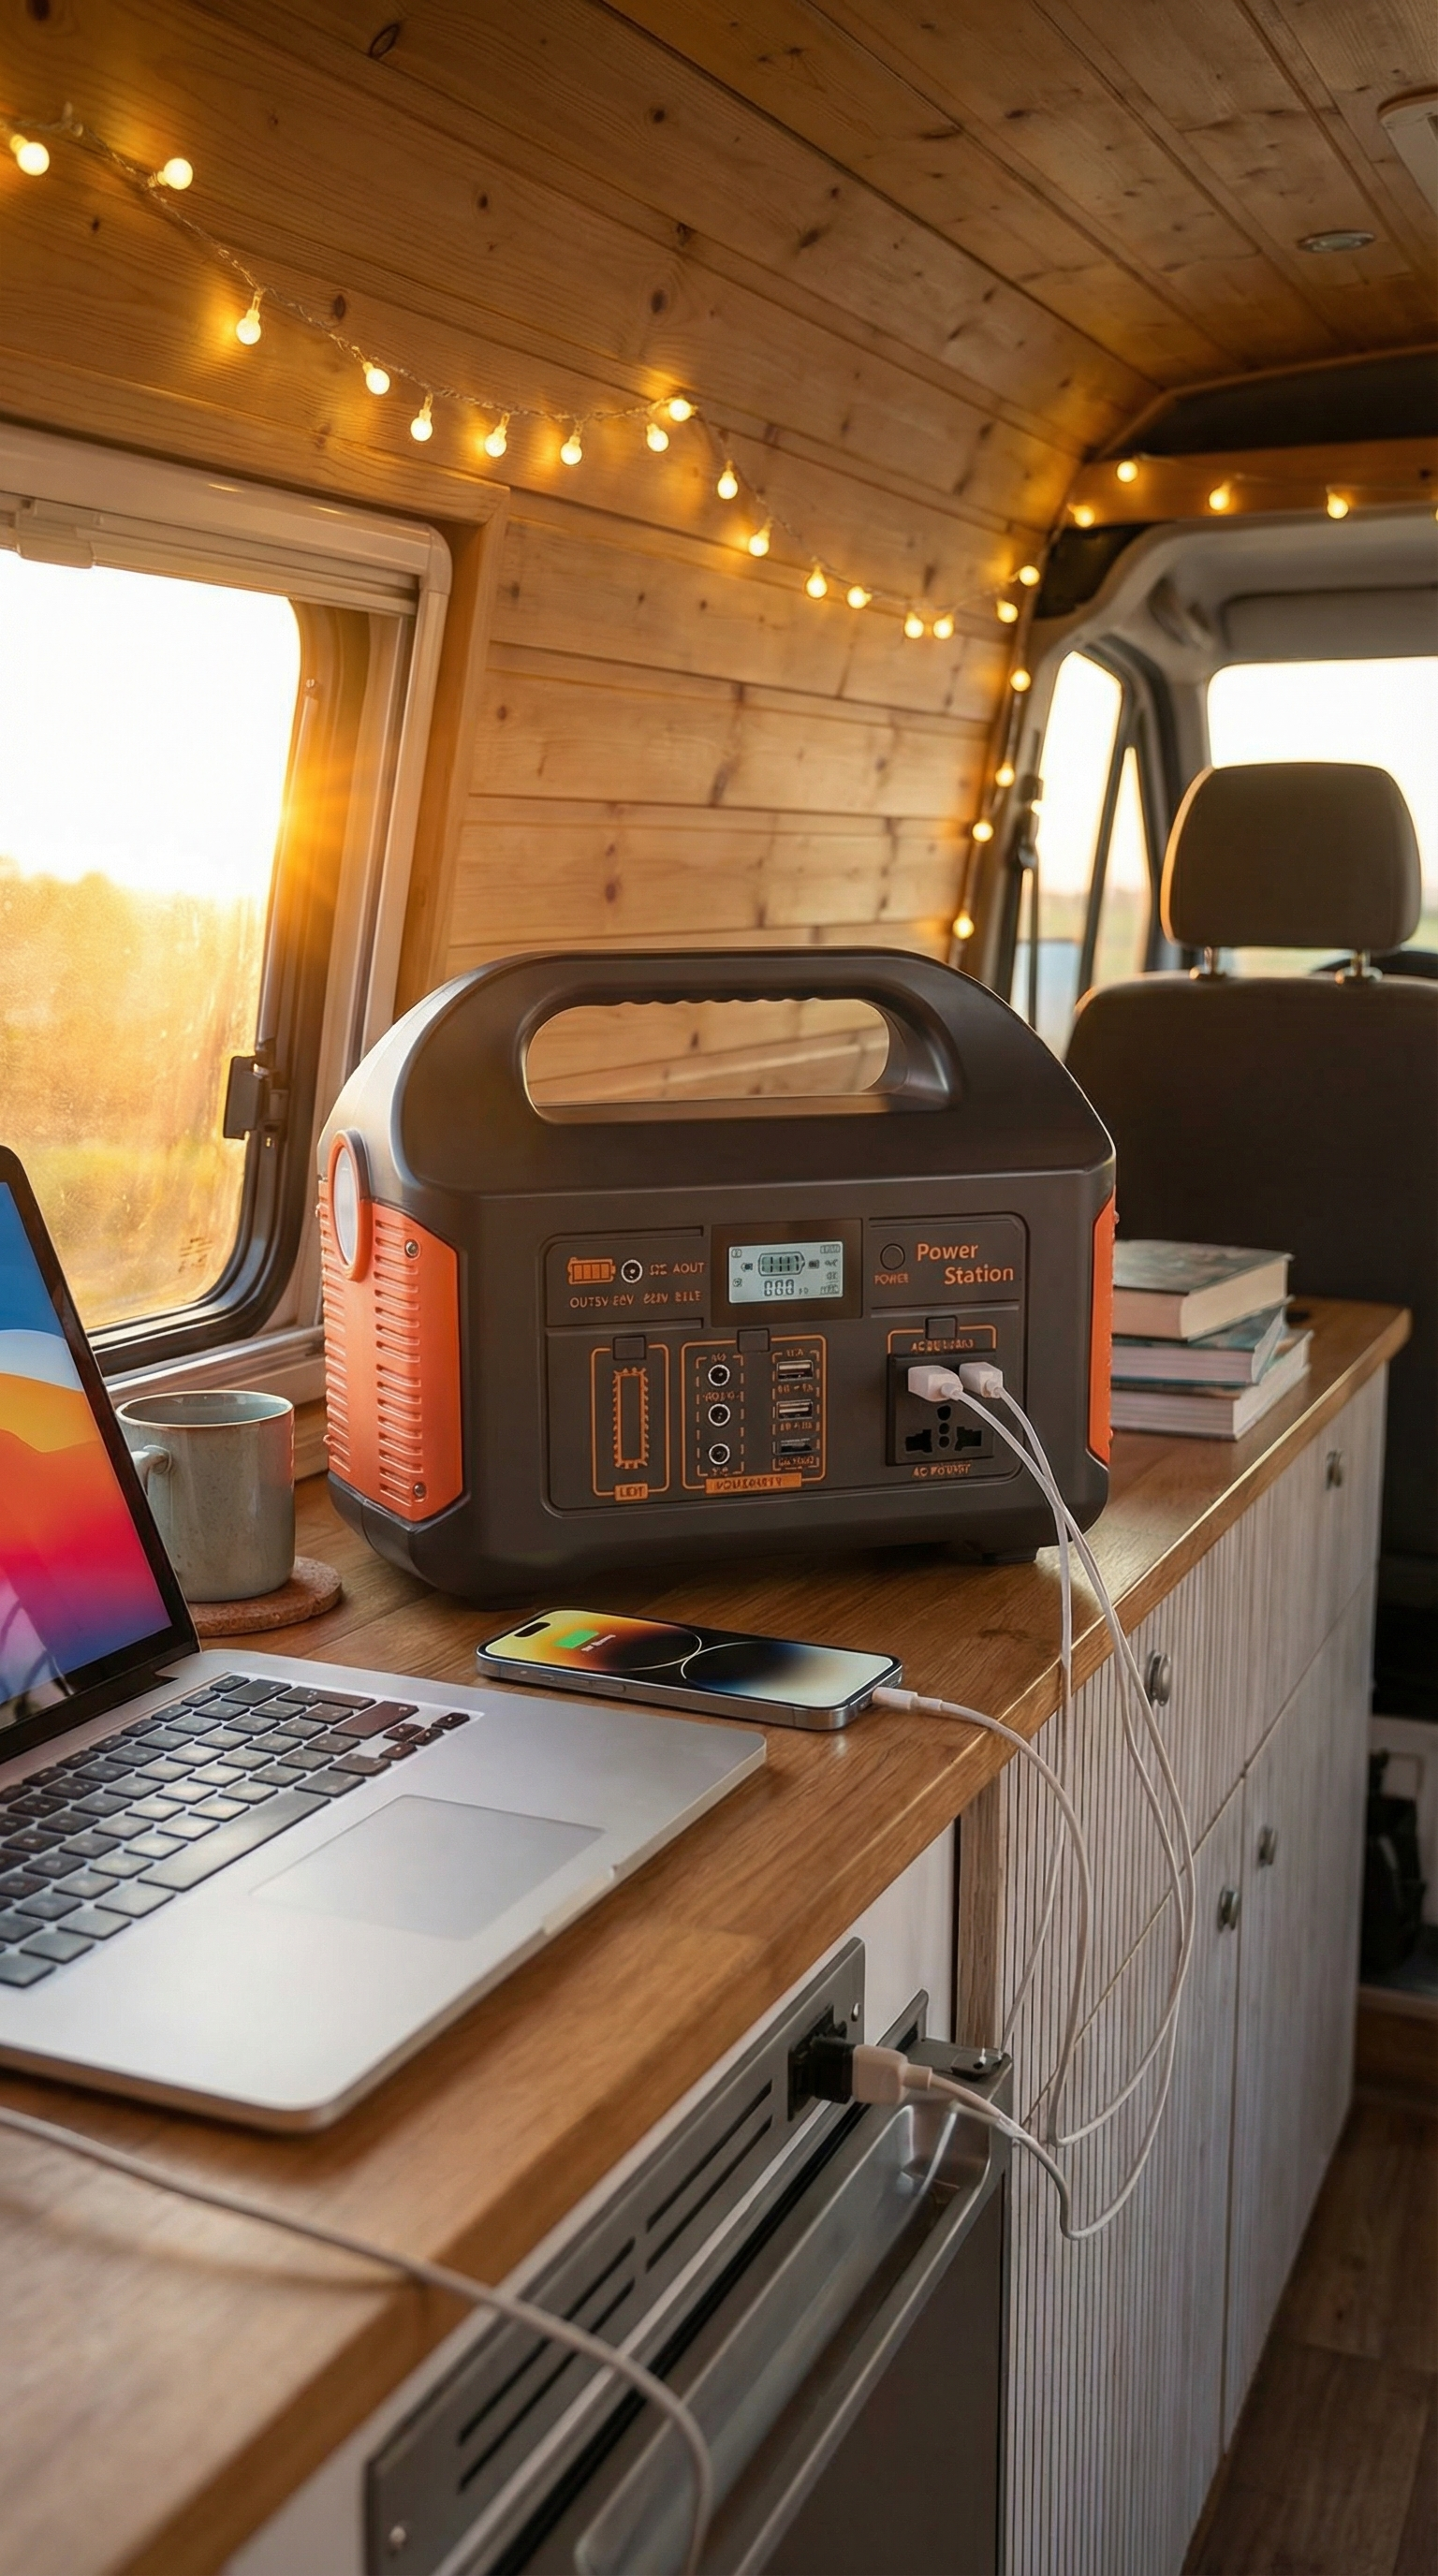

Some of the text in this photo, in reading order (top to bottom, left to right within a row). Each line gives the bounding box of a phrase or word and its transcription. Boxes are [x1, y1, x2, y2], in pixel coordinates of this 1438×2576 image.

[917, 1243, 979, 1262] Power
[672, 1262, 705, 1274] AOUT
[944, 1264, 1015, 1285] Station
